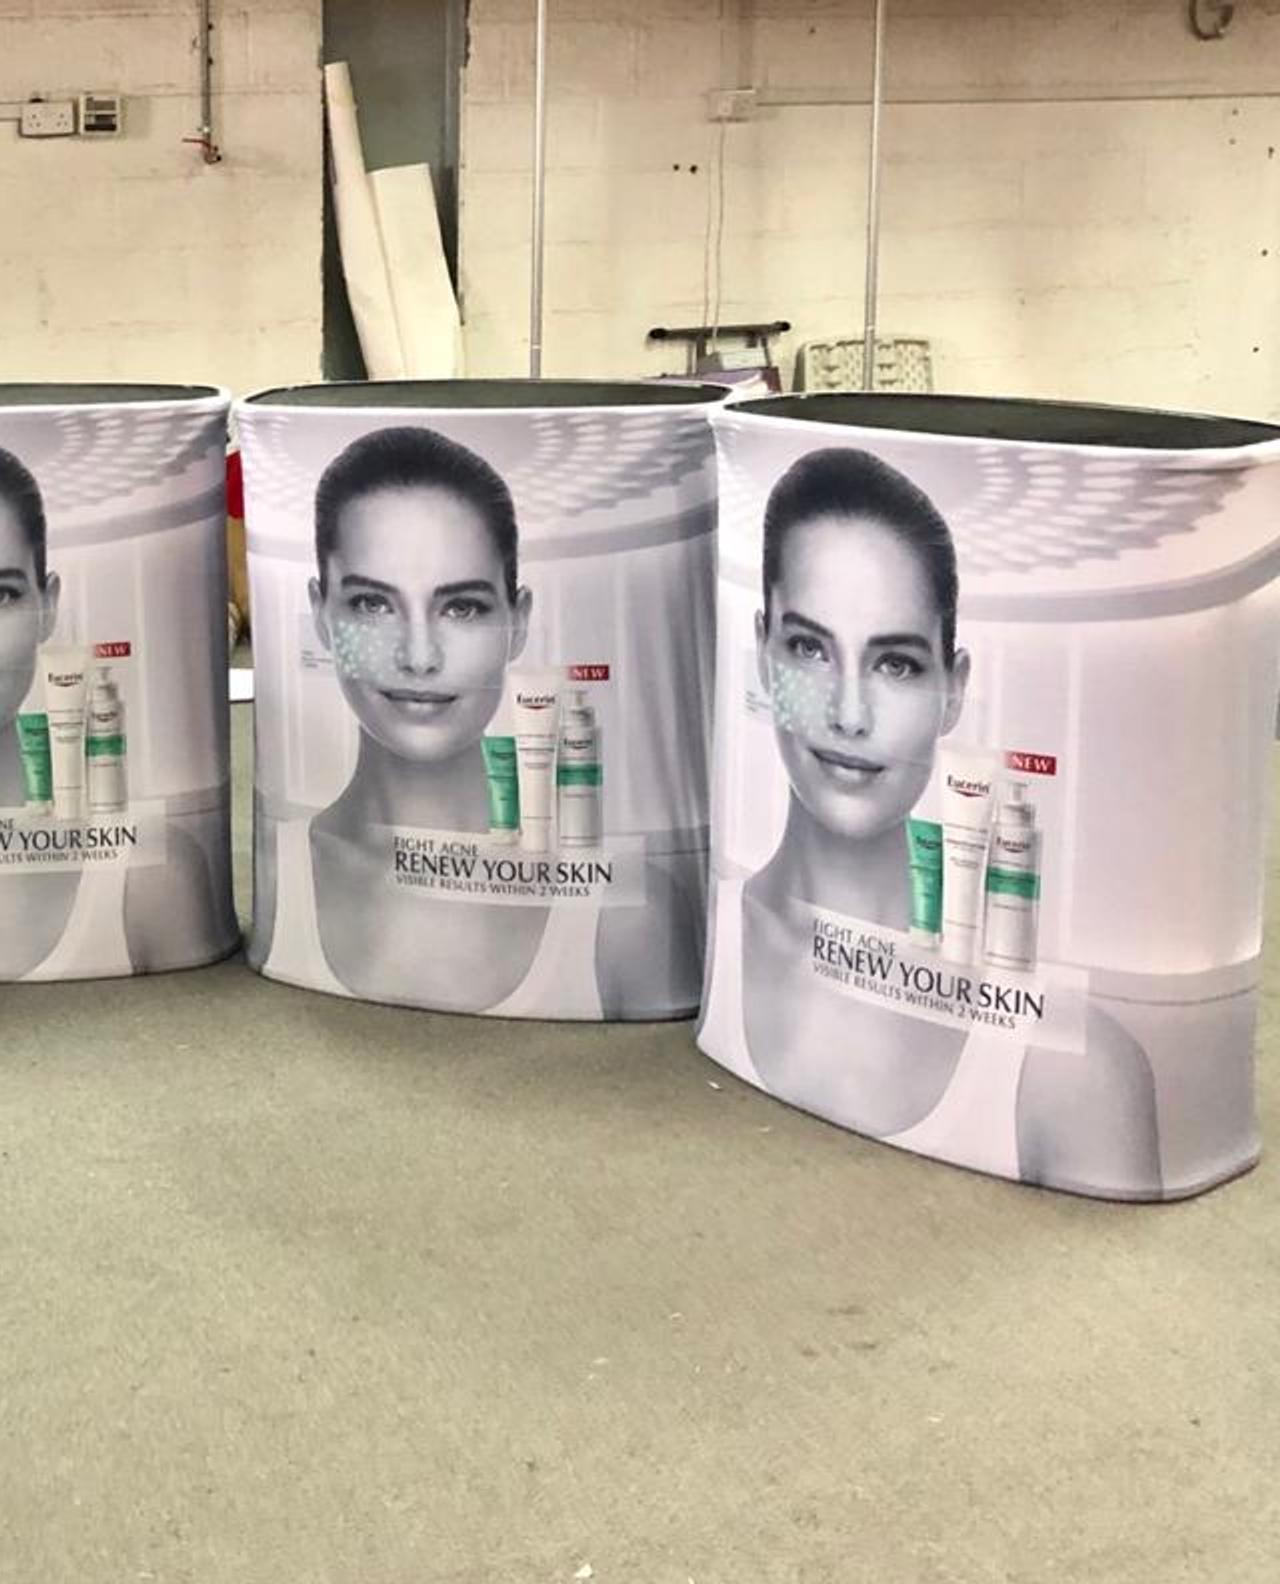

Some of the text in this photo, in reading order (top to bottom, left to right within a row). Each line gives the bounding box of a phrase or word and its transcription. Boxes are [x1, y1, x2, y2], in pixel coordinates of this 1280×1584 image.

[99, 643, 127, 656] NEW
[573, 667, 605, 678] NEW
[1012, 755, 1051, 772] NEW
[947, 775, 990, 794] Eucerin
[19, 829, 83, 851] YOUR
[86, 826, 137, 848] SKIN
[394, 836, 478, 856] FIGHT ACNE
[25, 851, 68, 863] WITHIN
[81, 850, 118, 861] WEEKS
[395, 850, 613, 885] RENEW YOUR SKIN
[396, 875, 435, 888] VISIBLE
[440, 878, 486, 893] RESULTS
[489, 883, 536, 897] WITHIN
[548, 885, 590, 897] WEEKS
[813, 919, 896, 957] FIGHT ACNE
[813, 936, 1045, 1019] RENEW YOUR SKIN
[813, 962, 850, 984] VISIBLE
[854, 974, 901, 1000] RESULTS
[905, 990, 954, 1014] WITHIN
[970, 1008, 1016, 1029] WEEKS
